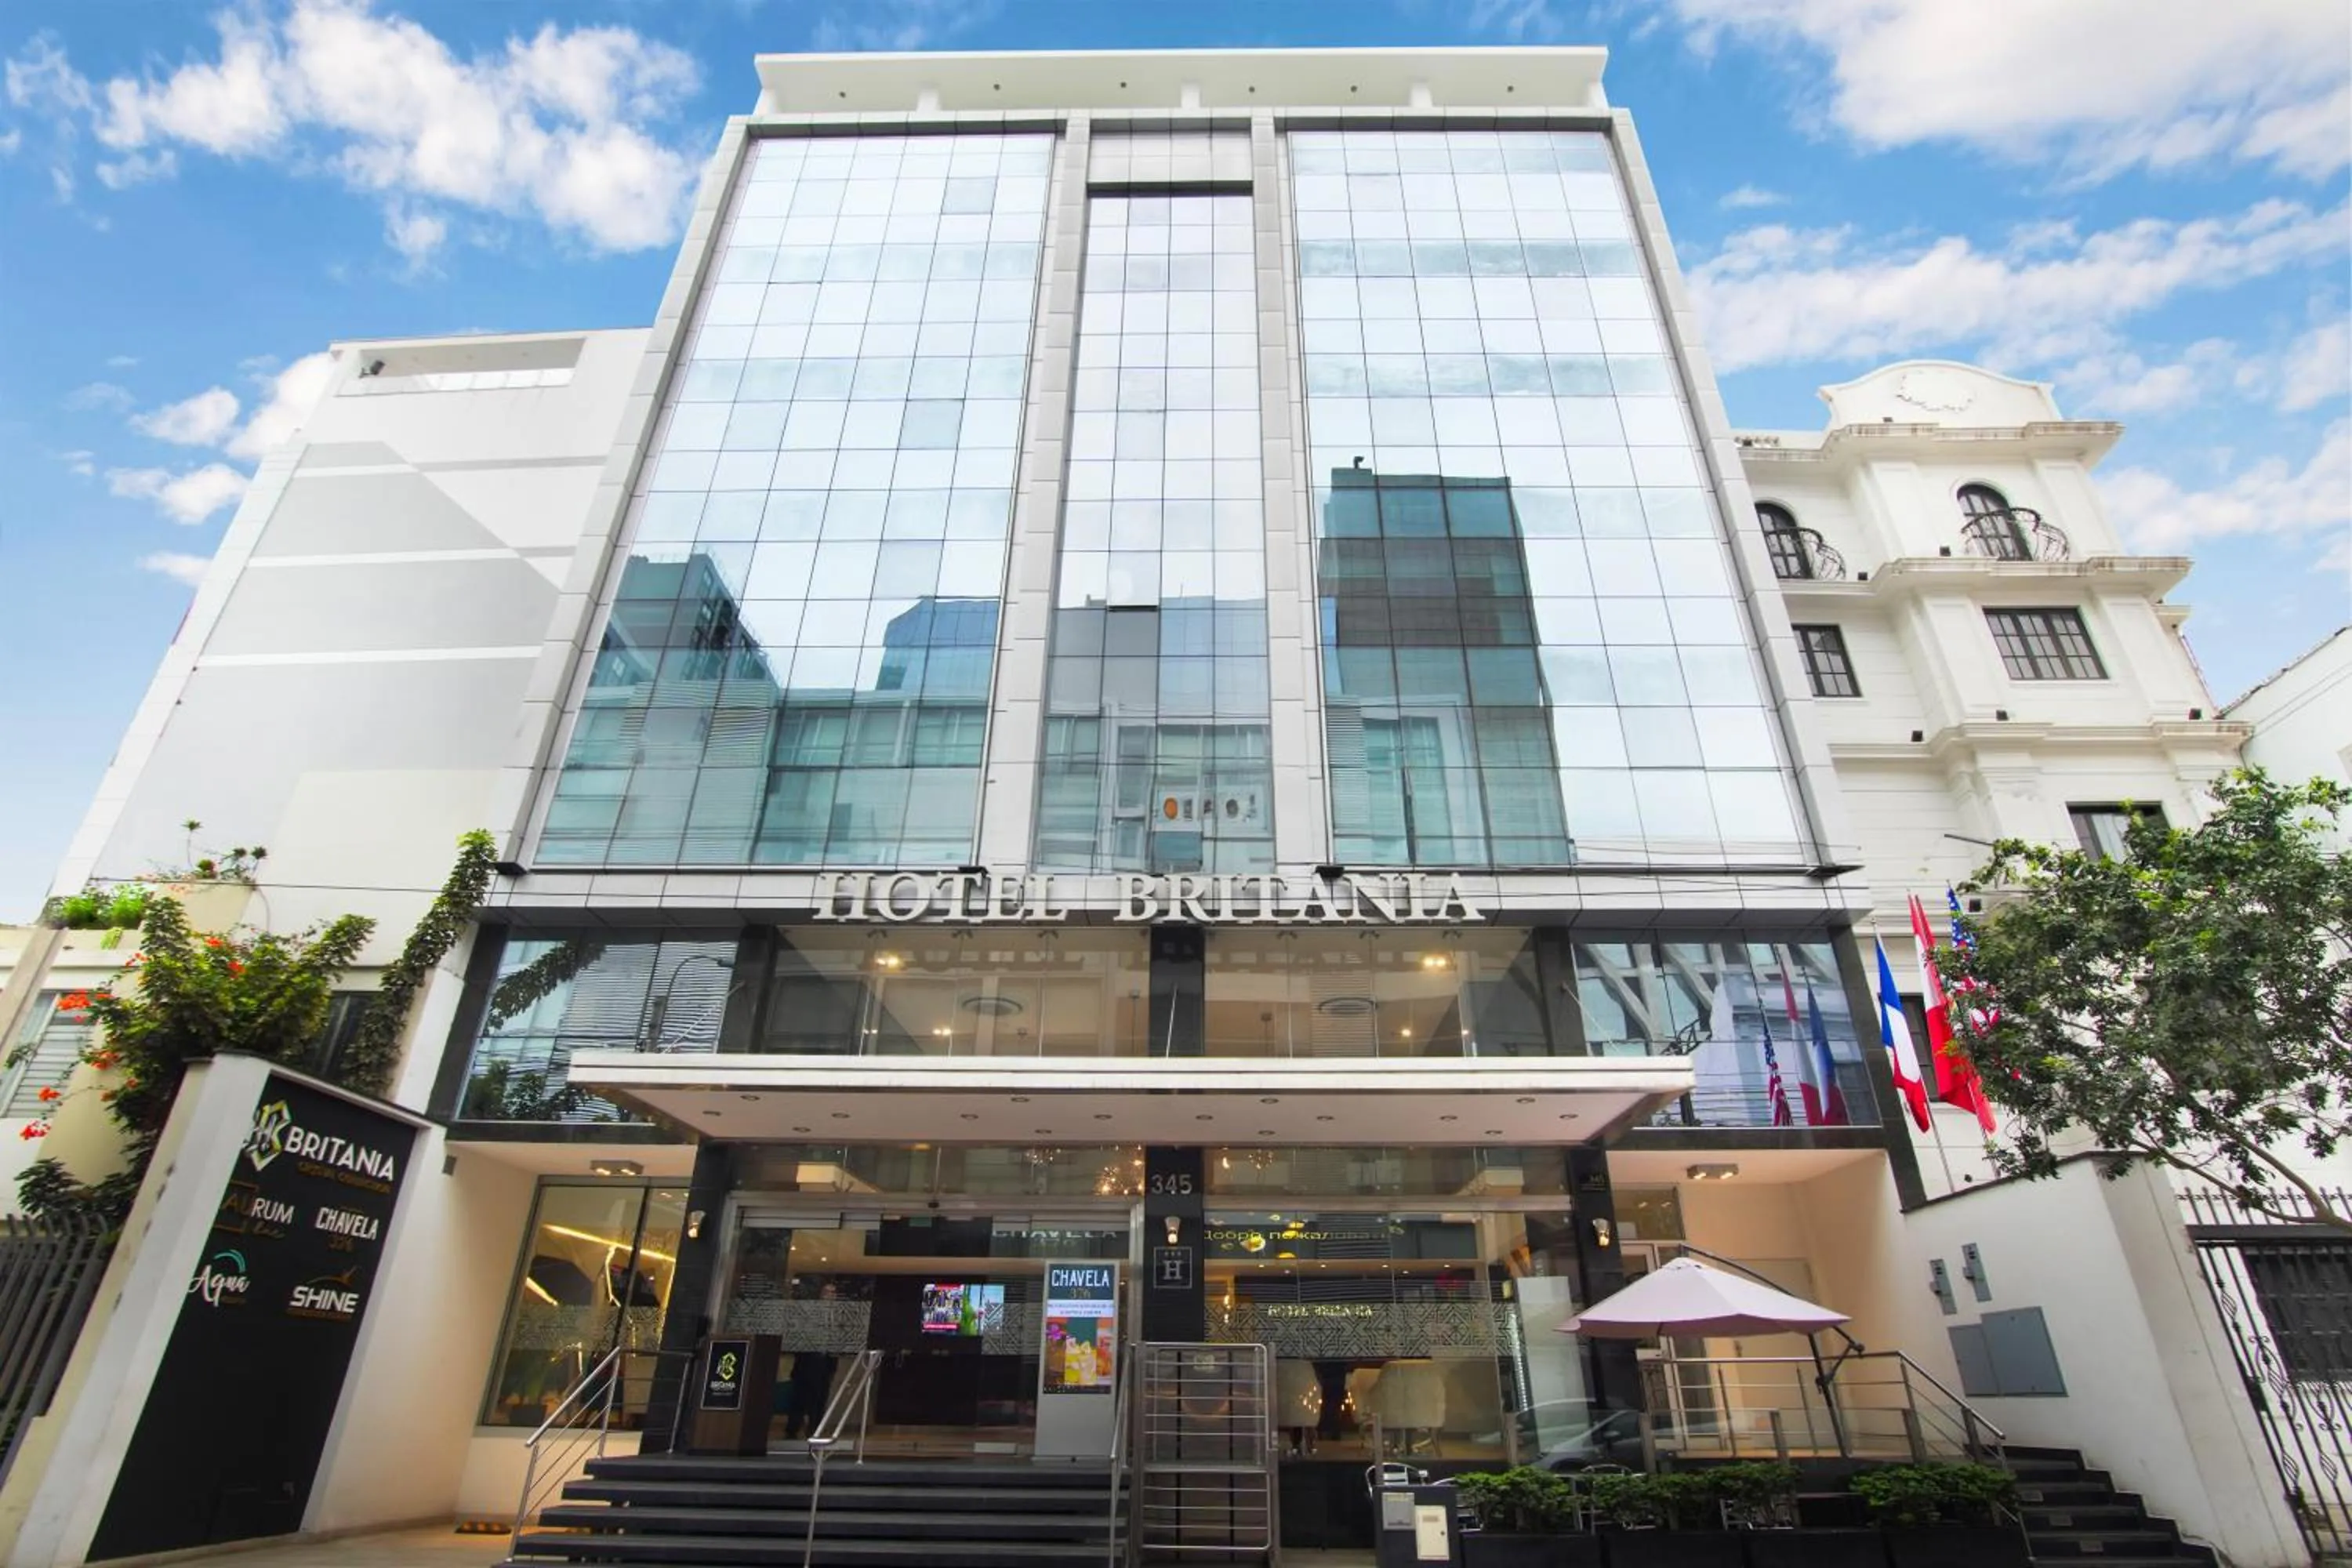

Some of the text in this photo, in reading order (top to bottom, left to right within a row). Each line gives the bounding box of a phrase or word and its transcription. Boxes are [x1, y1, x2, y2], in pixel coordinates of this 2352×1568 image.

[812, 872, 1486, 923] HOTEL BRITANIA
[285, 1126, 394, 1181] BRITANIA
[1152, 1174, 1192, 1195] 345
[315, 1207, 379, 1240] CHAVELA
[1051, 1269, 1109, 1287] CHAVELA
[1163, 1260, 1182, 1279] H
[187, 1264, 251, 1308] Aqua
[289, 1286, 358, 1313] SHINE
